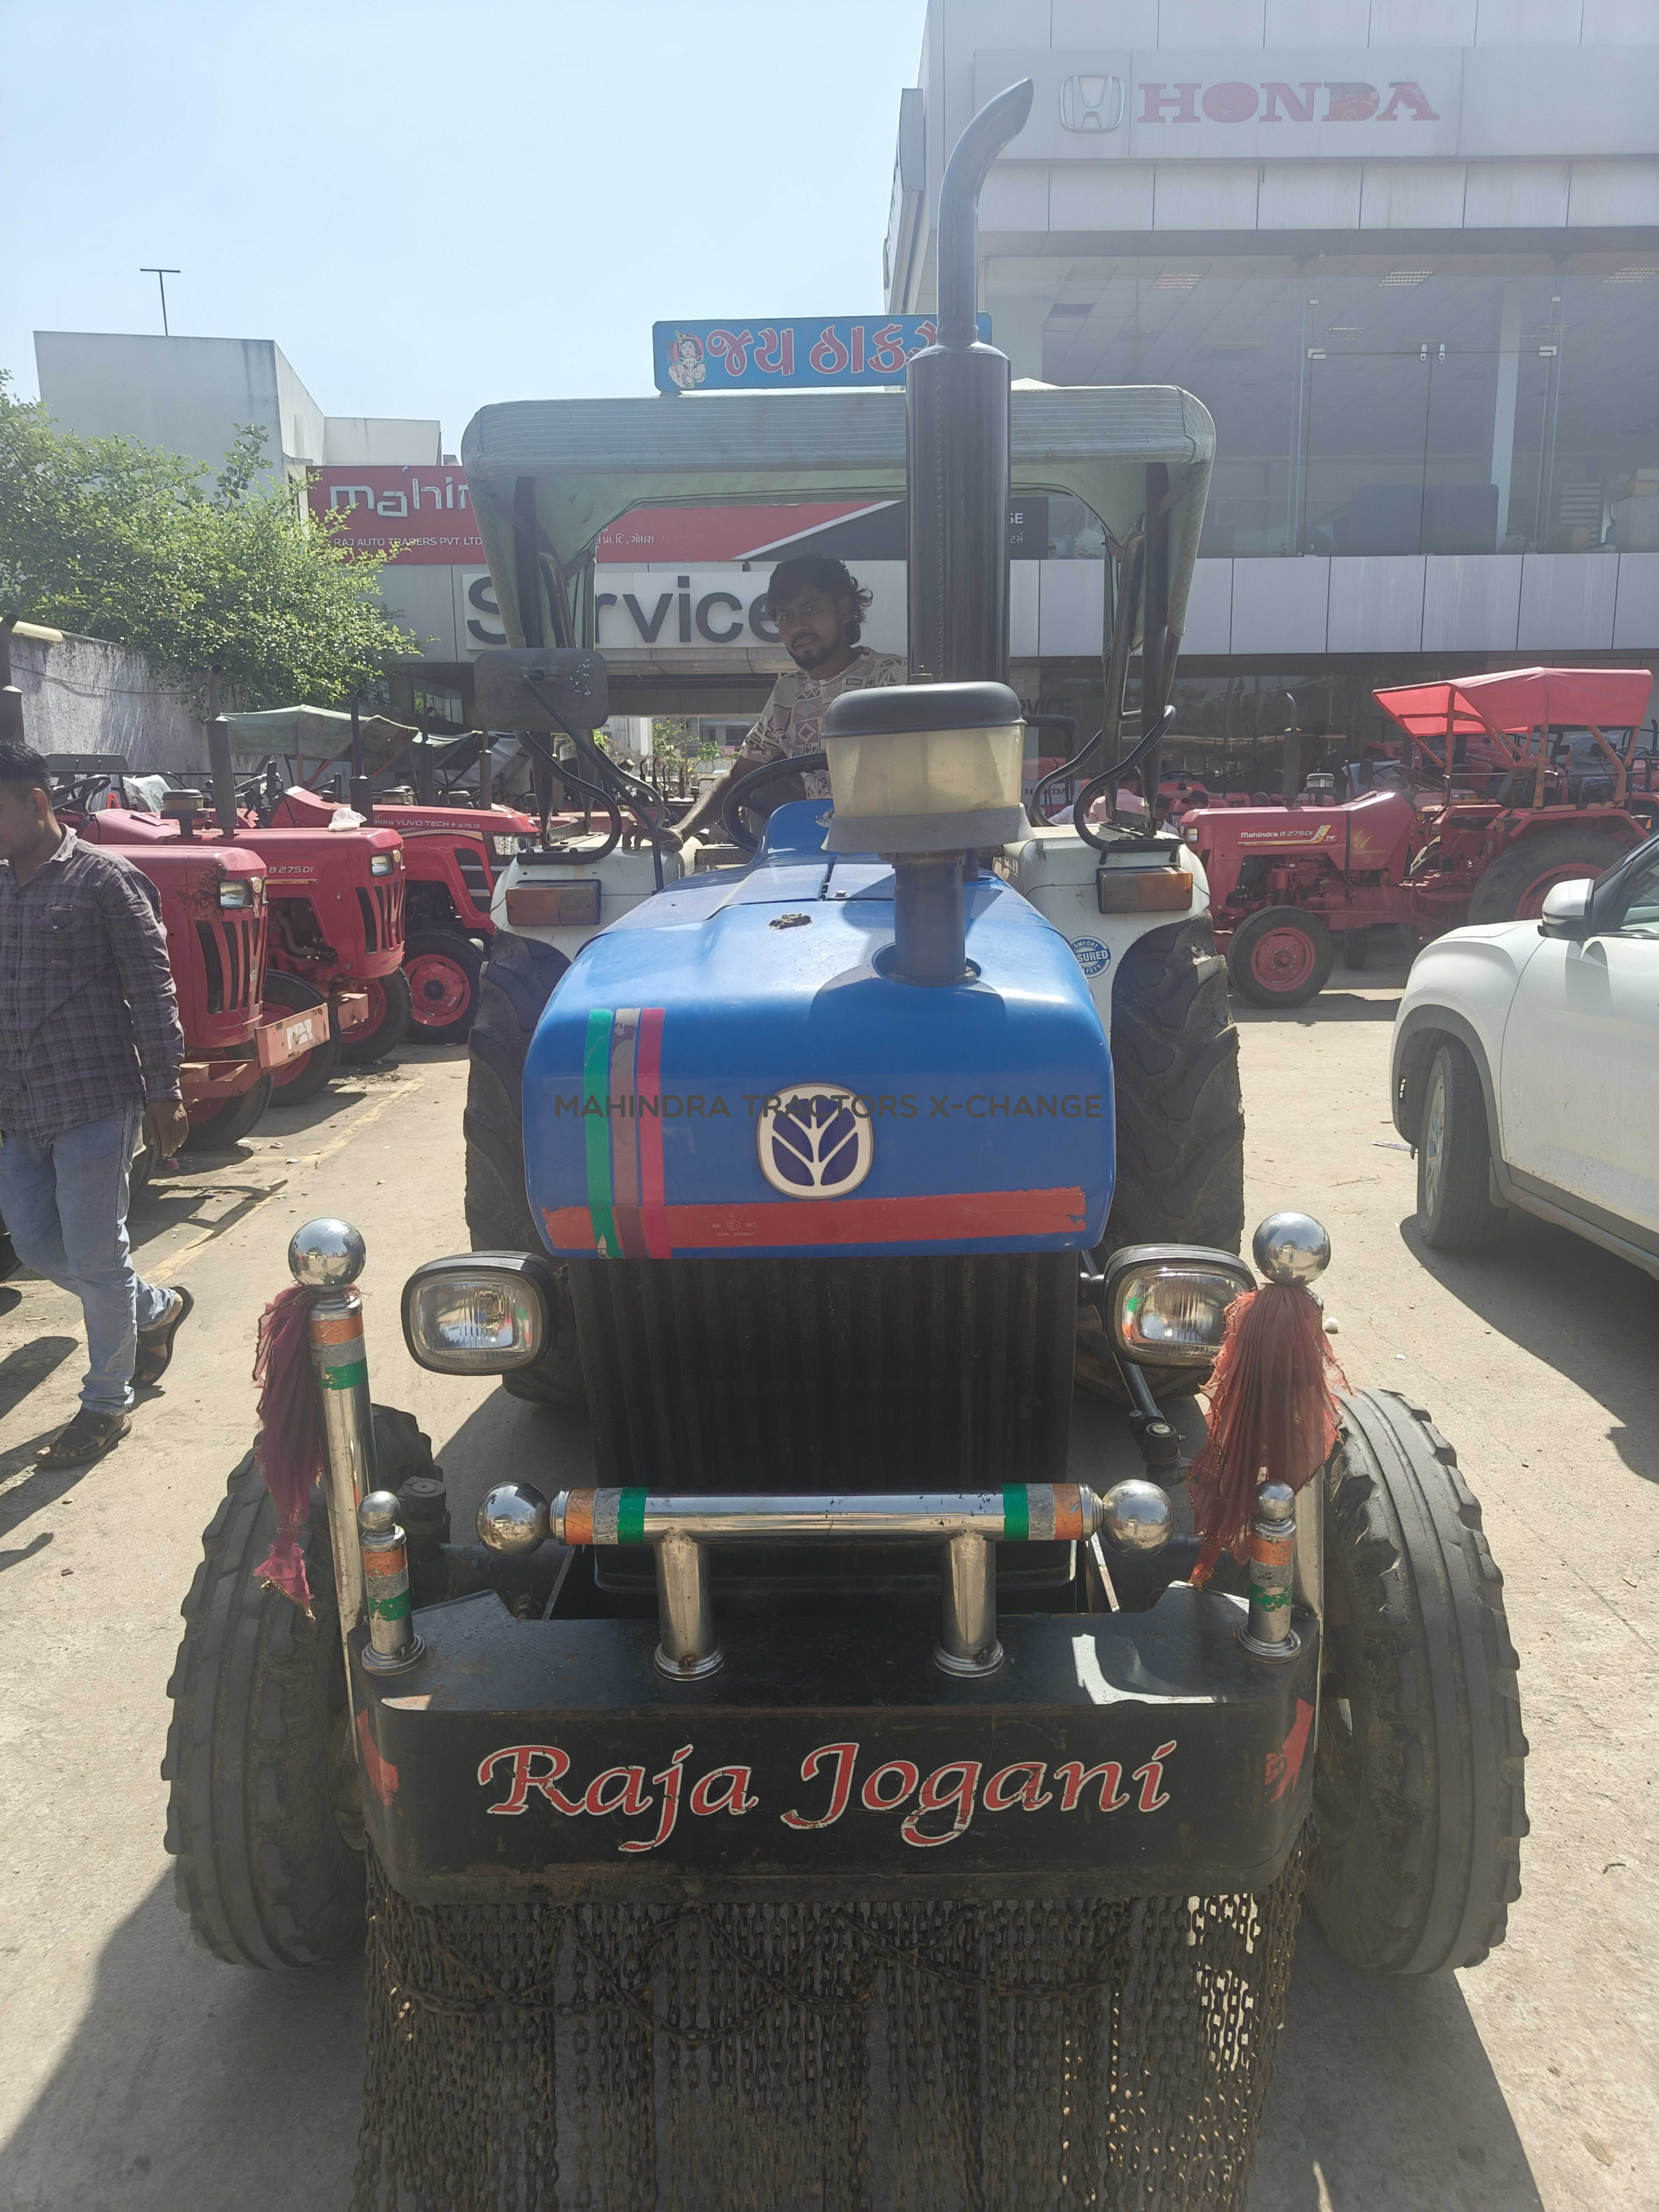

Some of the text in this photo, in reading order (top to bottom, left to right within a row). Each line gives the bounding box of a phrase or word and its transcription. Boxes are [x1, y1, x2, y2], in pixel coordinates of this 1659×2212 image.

[1137, 81, 1441, 124] HONDA
[706, 327, 794, 376] જય
[330, 477, 467, 517] mahi
[334, 538, 354, 547] RAJ
[357, 538, 385, 547] AUTO
[1074, 941, 1098, 951] OMFORT
[1077, 950, 1108, 962] SURED
[1083, 965, 1102, 974] FETY
[478, 1740, 1177, 1853] Raja Jogani
